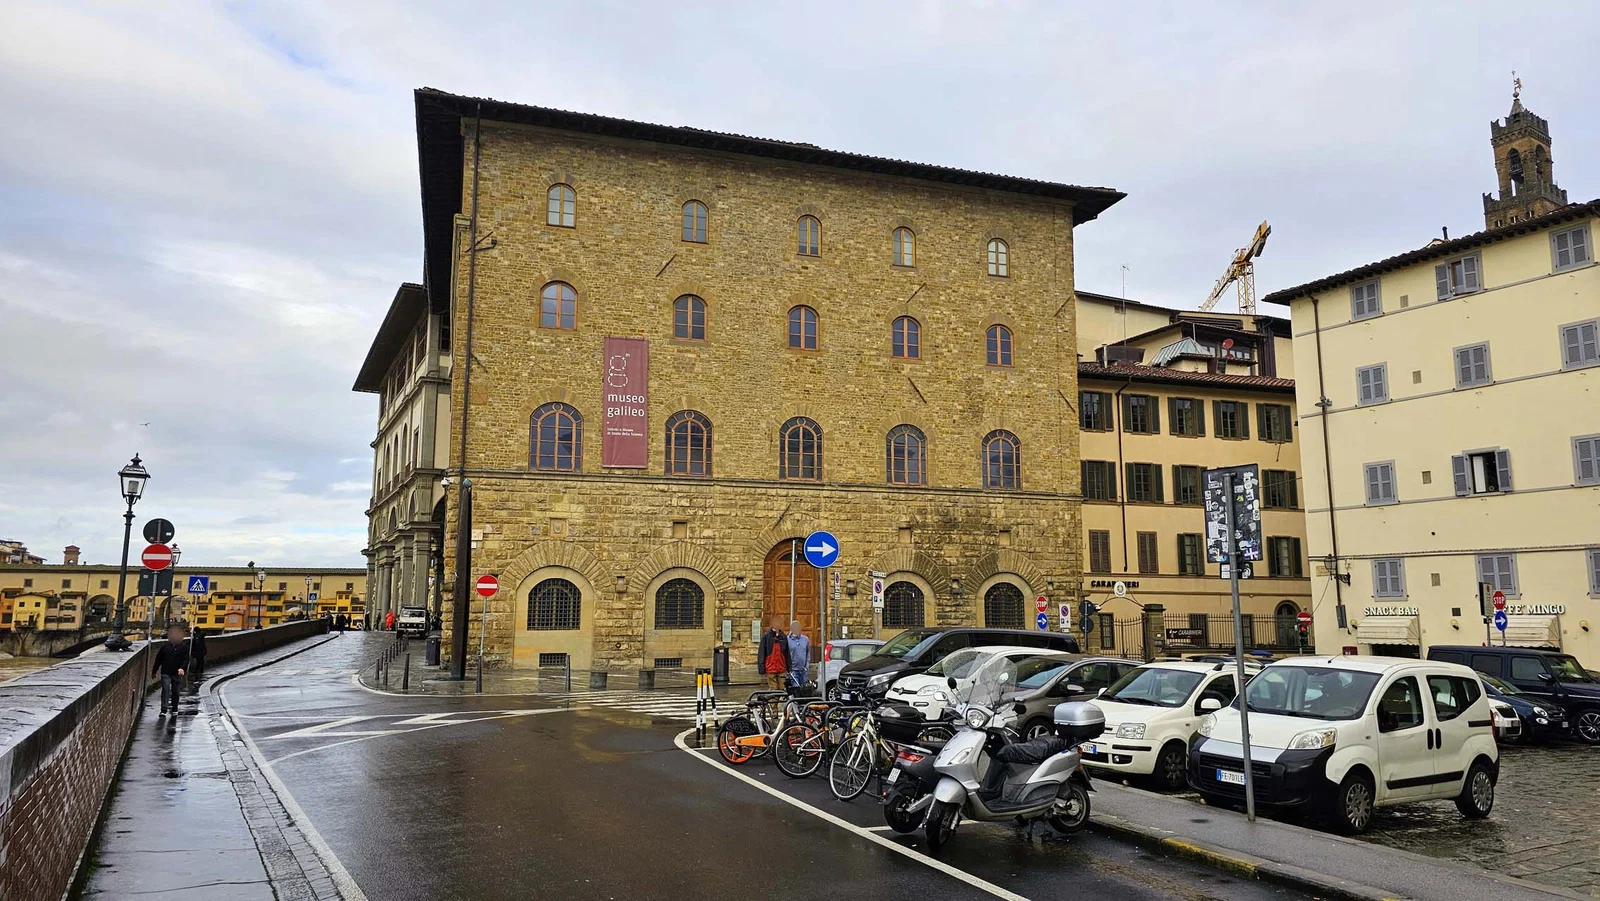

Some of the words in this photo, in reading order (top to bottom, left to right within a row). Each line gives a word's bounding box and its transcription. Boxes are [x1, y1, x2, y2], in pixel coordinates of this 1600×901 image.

[607, 393, 645, 404] museo
[607, 405, 645, 418] galileo
[1036, 600, 1048, 608] STOP
[1493, 596, 1505, 605] STOP
[1364, 606, 1396, 616] SNACK
[1398, 606, 1418, 616] BAR
[1527, 604, 1565, 614] MINGO
